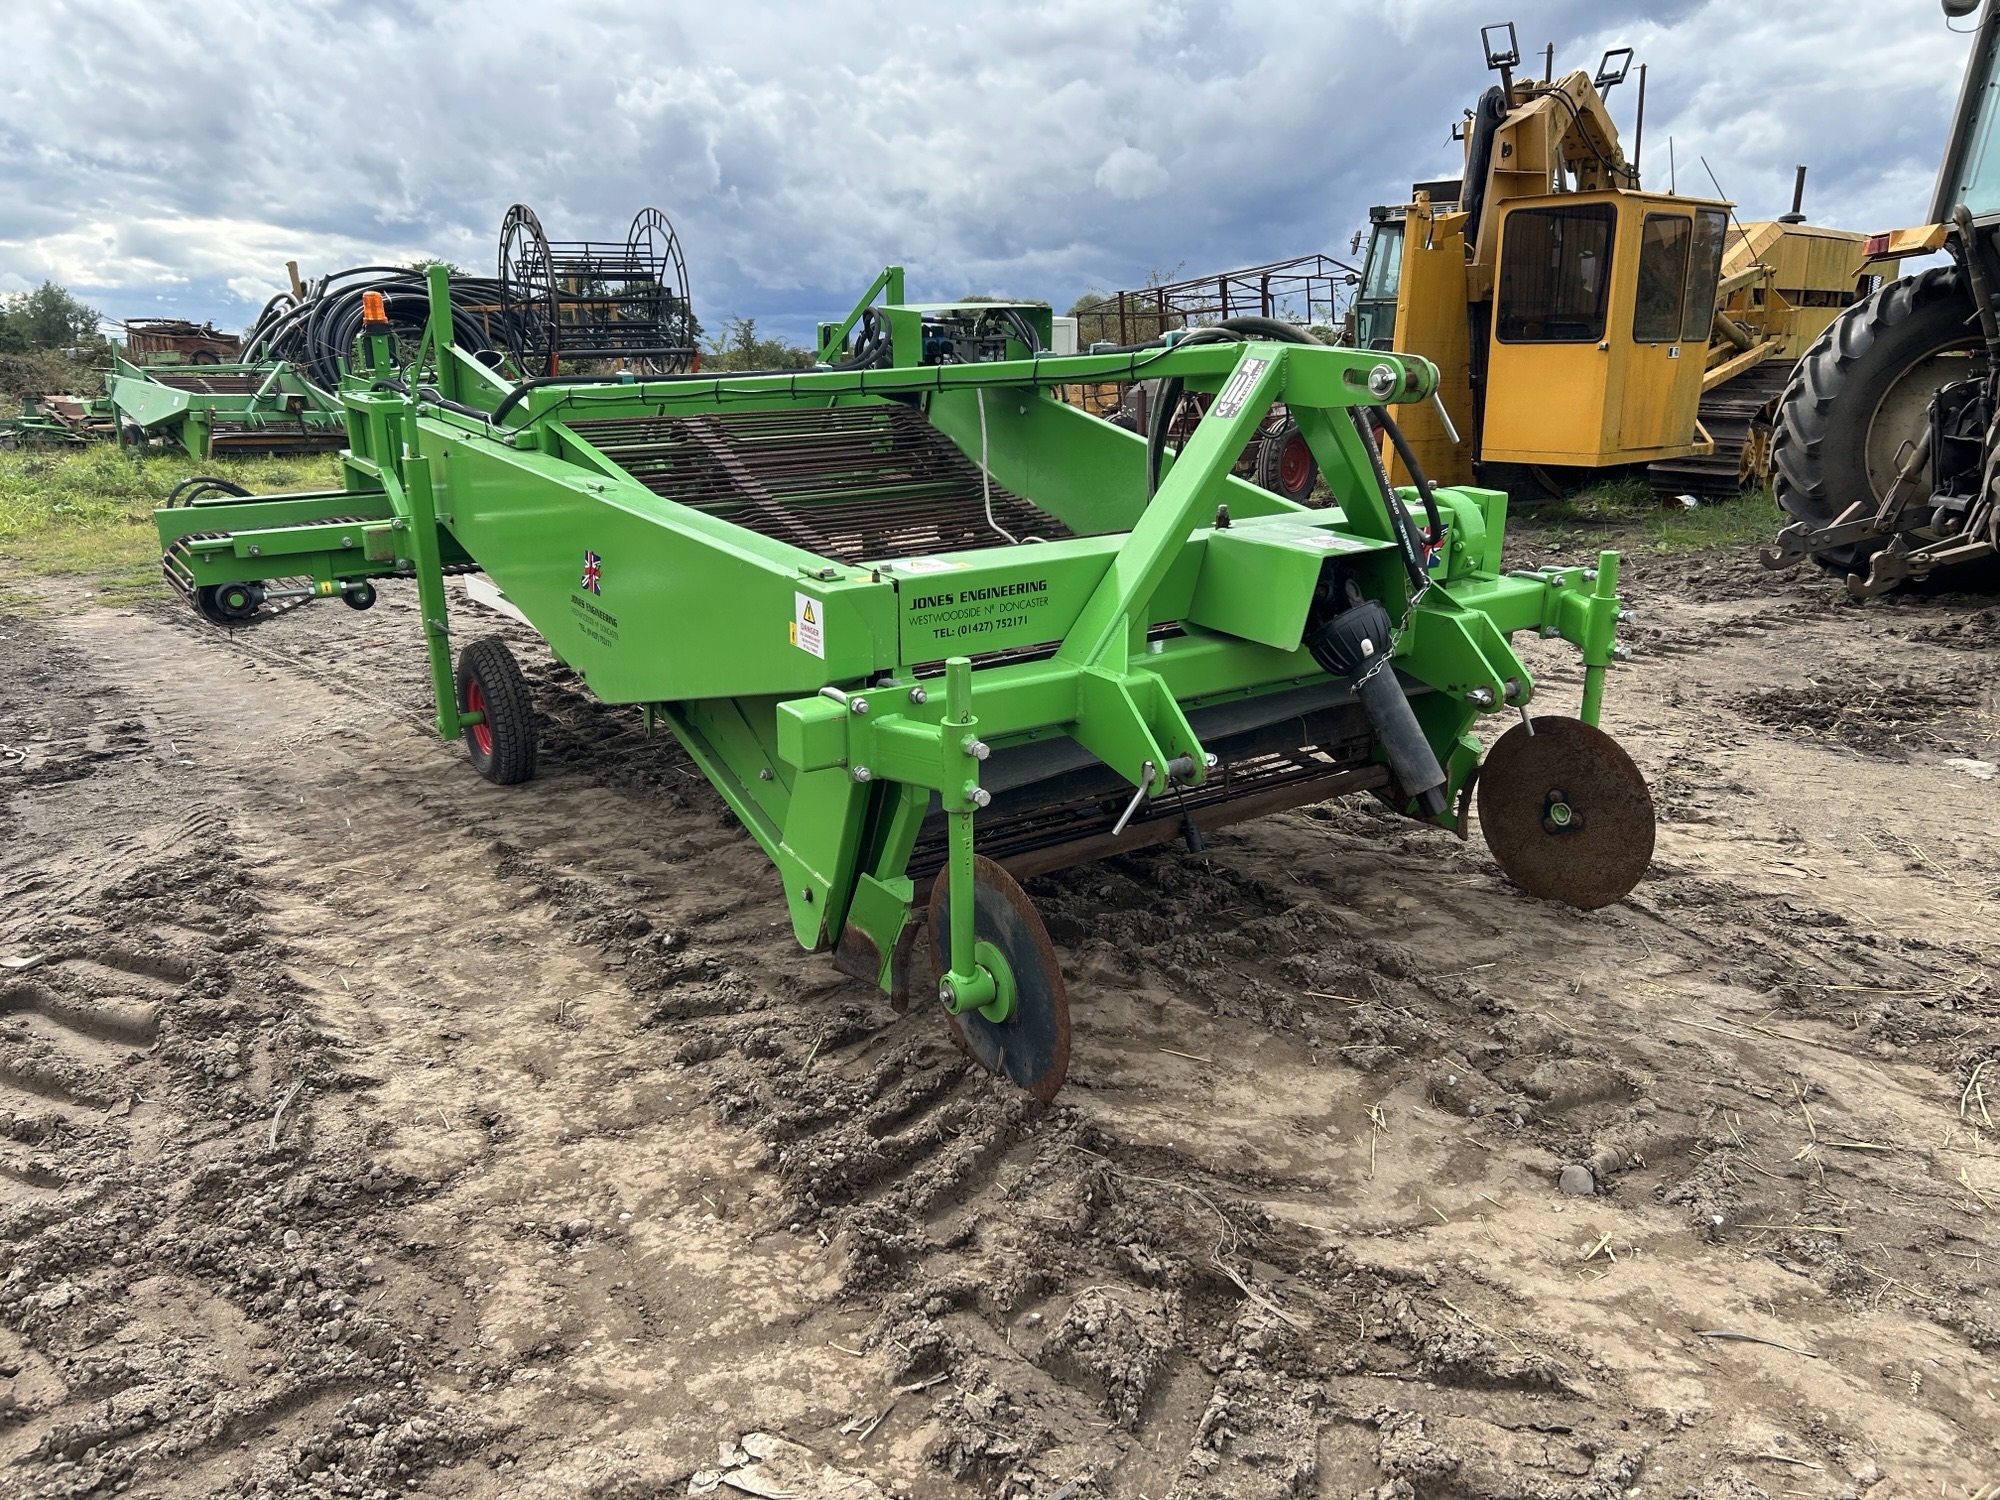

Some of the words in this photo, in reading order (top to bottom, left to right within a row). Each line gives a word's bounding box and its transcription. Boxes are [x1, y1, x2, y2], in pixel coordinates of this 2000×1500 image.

[909, 593, 954, 611] JONES
[960, 579, 1047, 603] ENGINEERING
[571, 594, 585, 609] JONES
[586, 602, 618, 628] ENGINEERING
[908, 606, 981, 627] WESTWOODSIDE
[999, 596, 1049, 613] DONCASTER
[932, 628, 955, 639] TEL:
[957, 620, 994, 638] (01427)
[995, 614, 1029, 630] 752171
